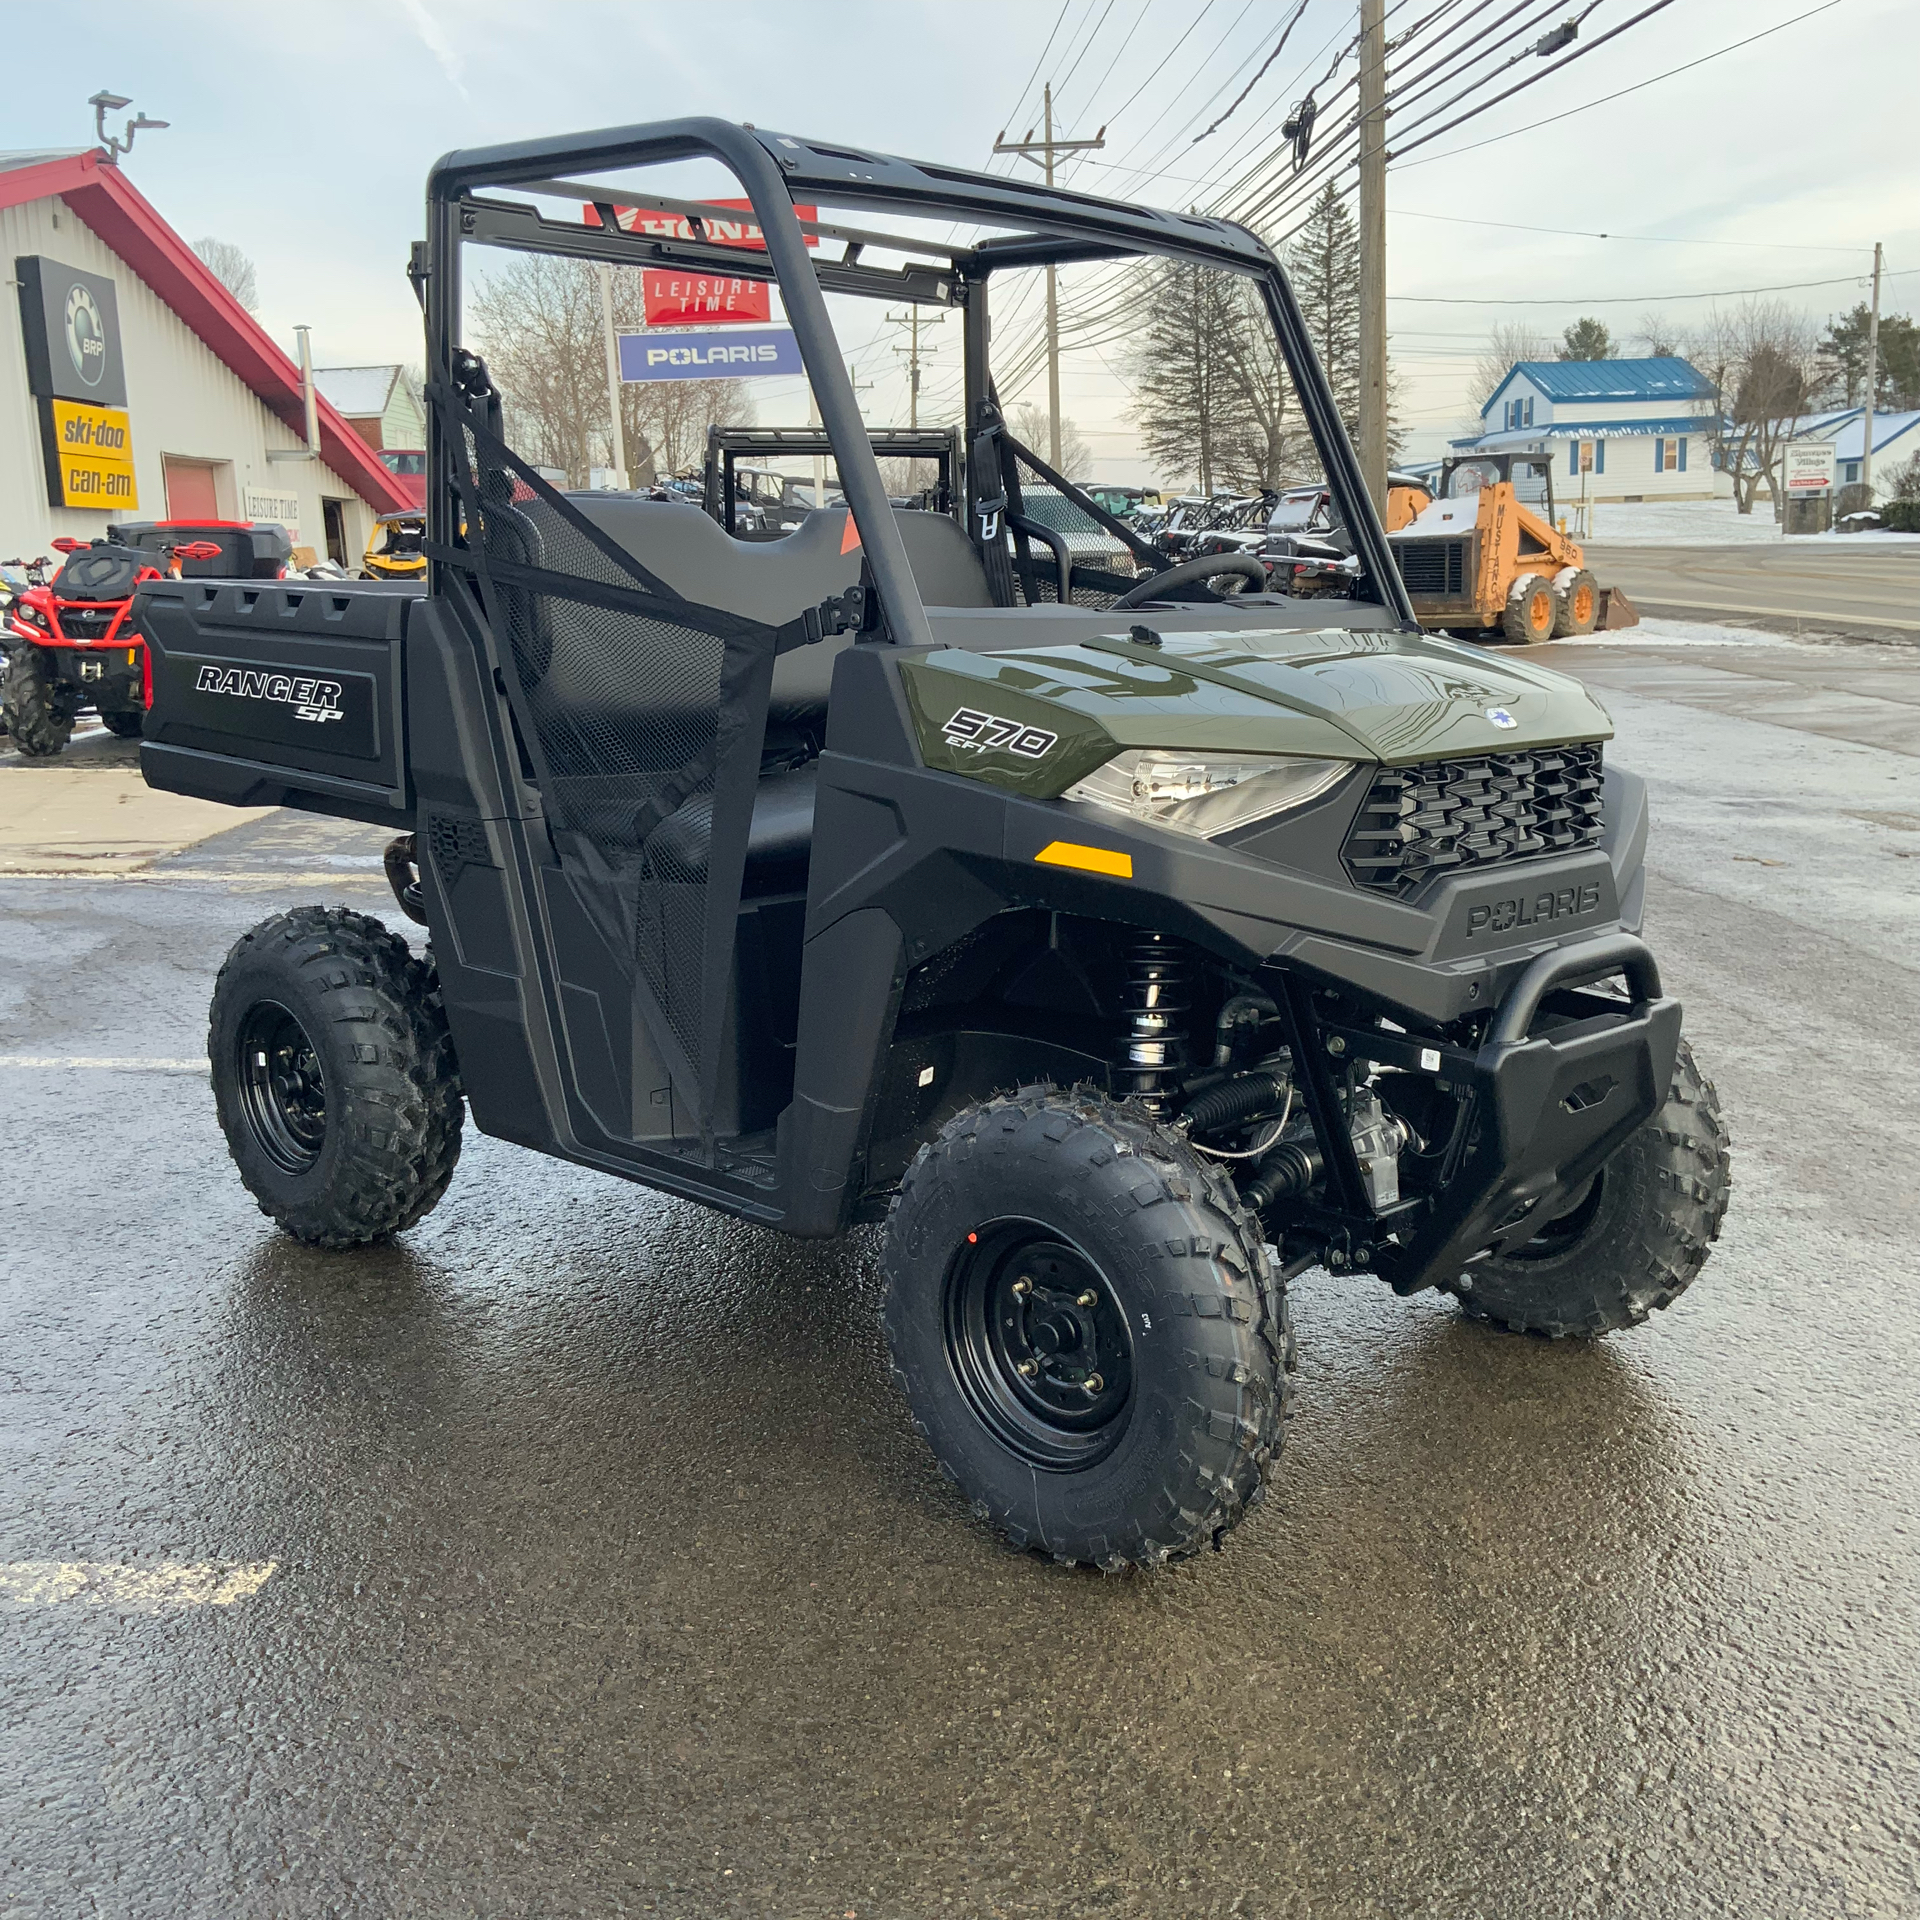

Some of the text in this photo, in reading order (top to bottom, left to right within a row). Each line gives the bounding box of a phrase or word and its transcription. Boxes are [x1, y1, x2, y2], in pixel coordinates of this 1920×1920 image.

[655, 279, 758, 298] LEISURE
[680, 295, 736, 313] TIME
[83, 338, 103, 356] BRP
[647, 345, 778, 366] POLARIS
[64, 415, 125, 449] ski-doo
[69, 468, 131, 497] can-am
[248, 496, 298, 519] LEISURE TIME
[196, 665, 342, 709] RANGER
[295, 706, 344, 722] SP
[941, 706, 1059, 758] 570
[945, 735, 987, 754] EFI
[1466, 882, 1600, 939] POLARIS
